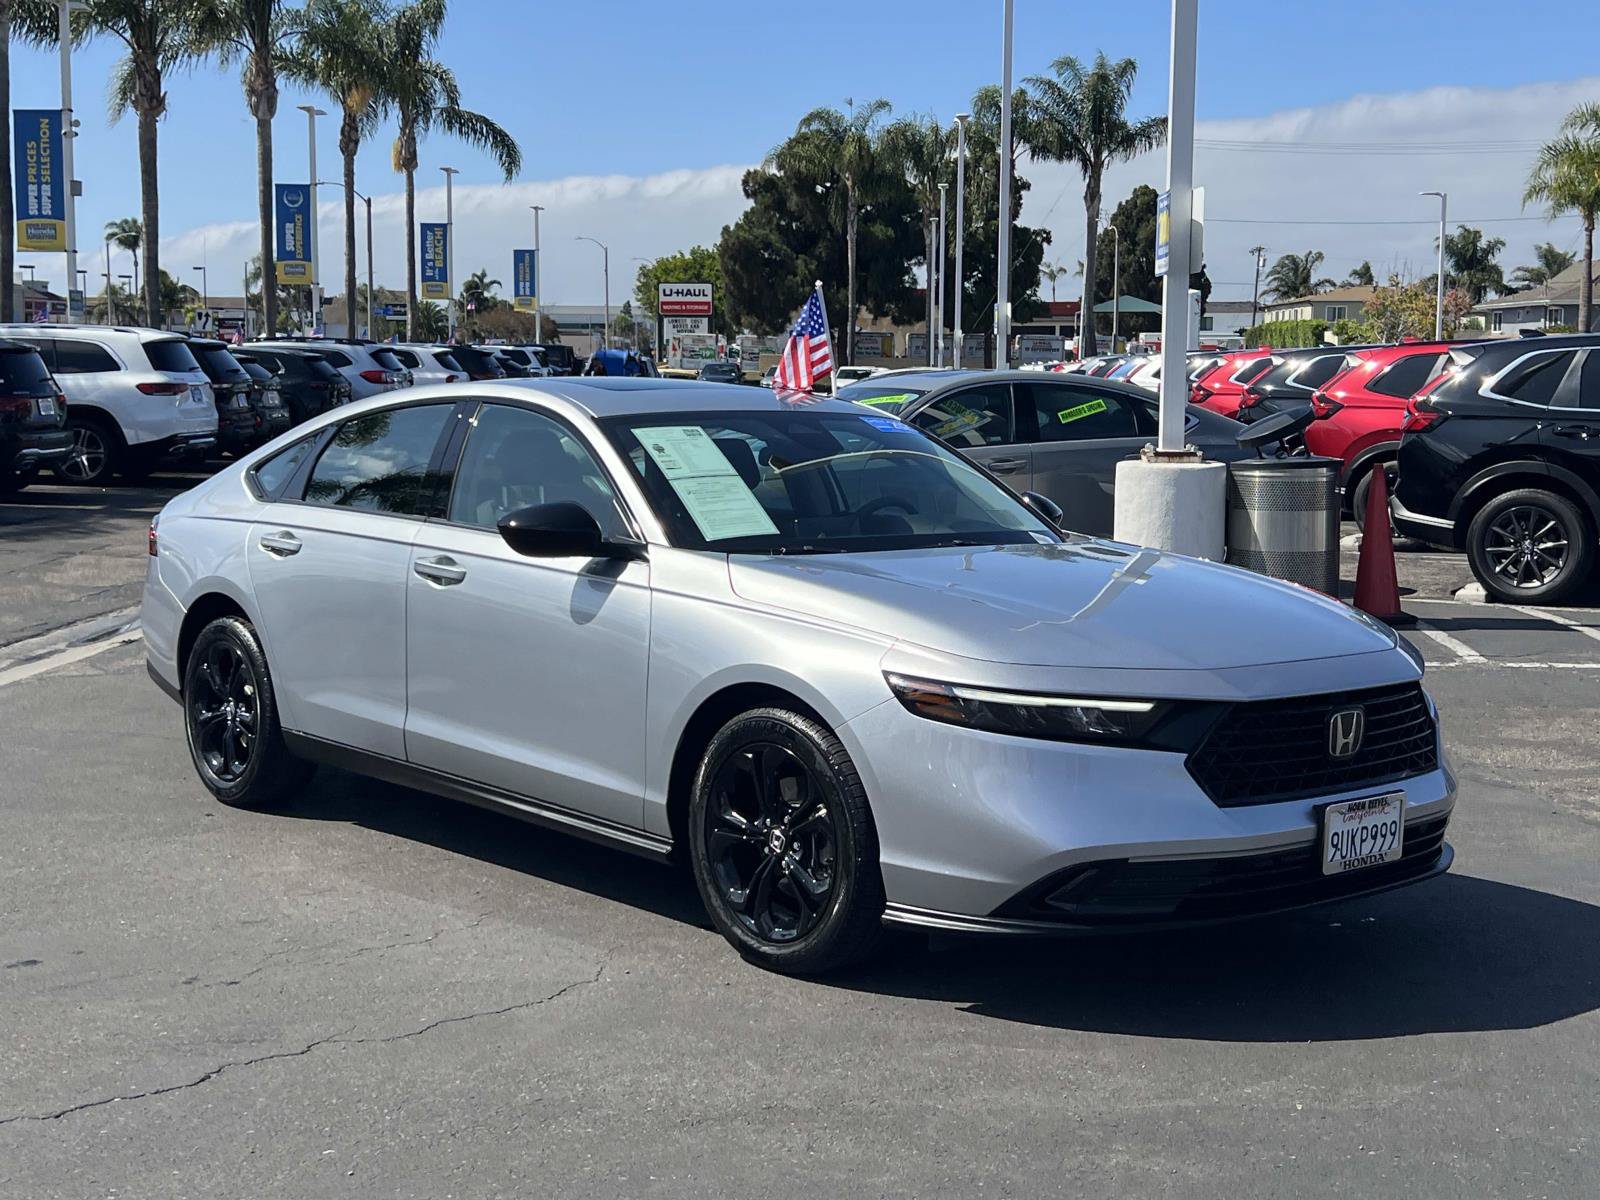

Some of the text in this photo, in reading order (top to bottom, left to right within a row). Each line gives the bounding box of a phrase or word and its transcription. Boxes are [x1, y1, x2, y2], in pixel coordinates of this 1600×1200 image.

[27, 140, 38, 216] SUPER PRICES
[40, 118, 52, 216] SUPER SELECTION
[285, 222, 295, 252] SUPER
[425, 230, 433, 276] It's Better
[434, 227, 444, 268] BEACH!
[662, 288, 709, 297] U-HAUL
[1329, 820, 1397, 862] 9UKP999
[1343, 852, 1386, 870] HONDA
